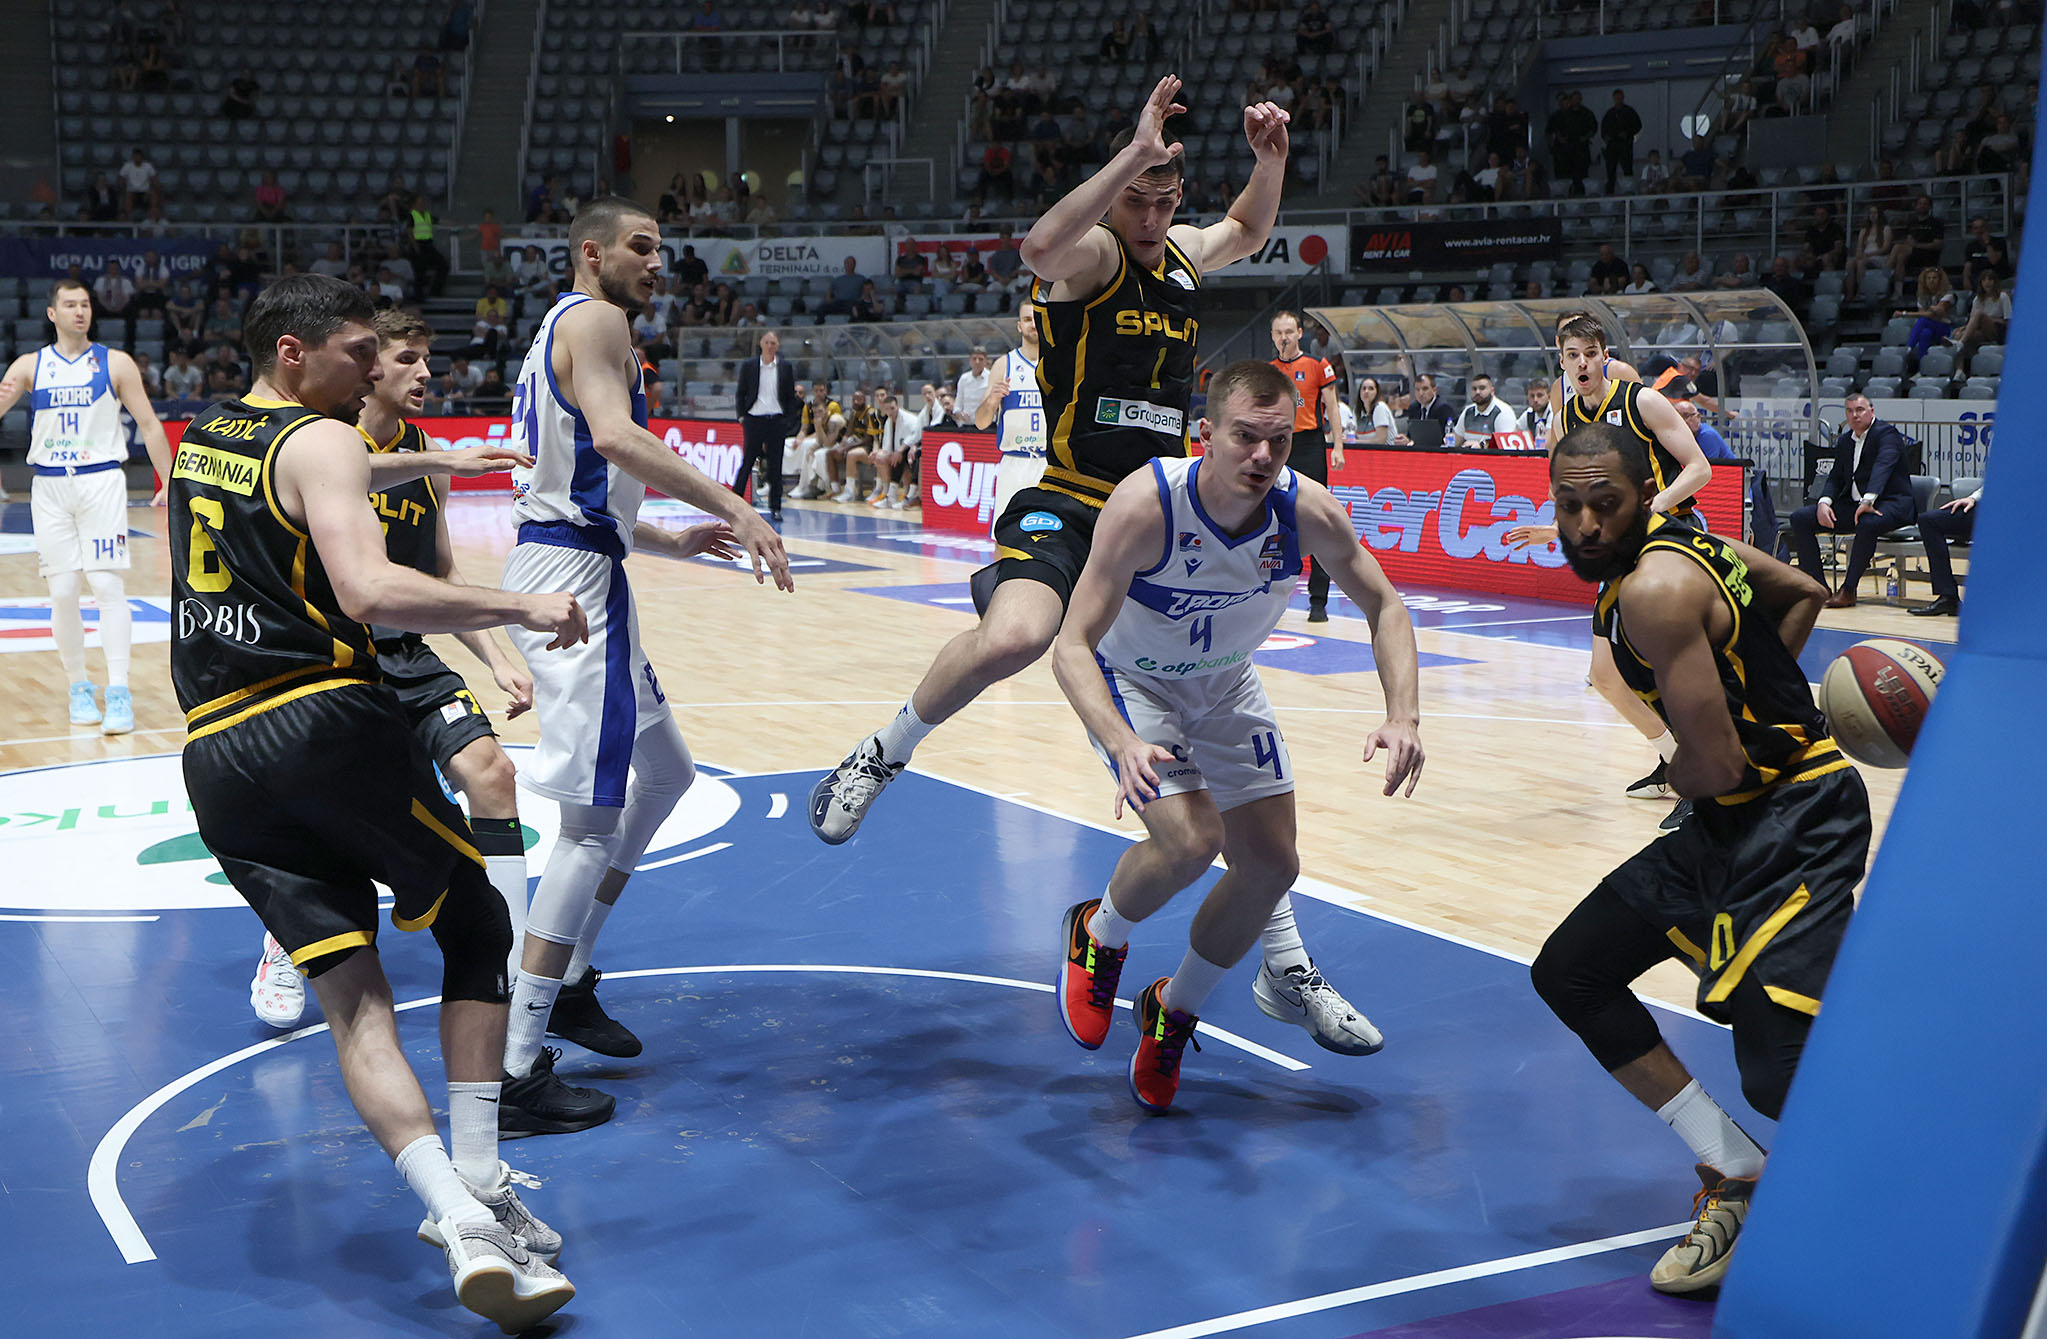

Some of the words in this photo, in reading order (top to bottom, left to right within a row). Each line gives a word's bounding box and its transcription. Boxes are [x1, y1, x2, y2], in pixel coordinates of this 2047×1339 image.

[1365, 232, 1411, 250] AVIA
[1444, 234, 1551, 248] www.avia-rentacar.hr
[759, 246, 819, 261] DELTA
[48, 386, 93, 407] ZADAR
[58, 412, 79, 434] 14
[201, 415, 270, 441] KATIĆ
[1125, 404, 1182, 430] Groupama
[50, 450, 79, 462] PSK
[92, 538, 114, 560] 14
[186, 495, 233, 593] 6
[1259, 560, 1281, 570] AVIA
[1190, 615, 1214, 653] 4
[1252, 731, 1283, 780] 4
